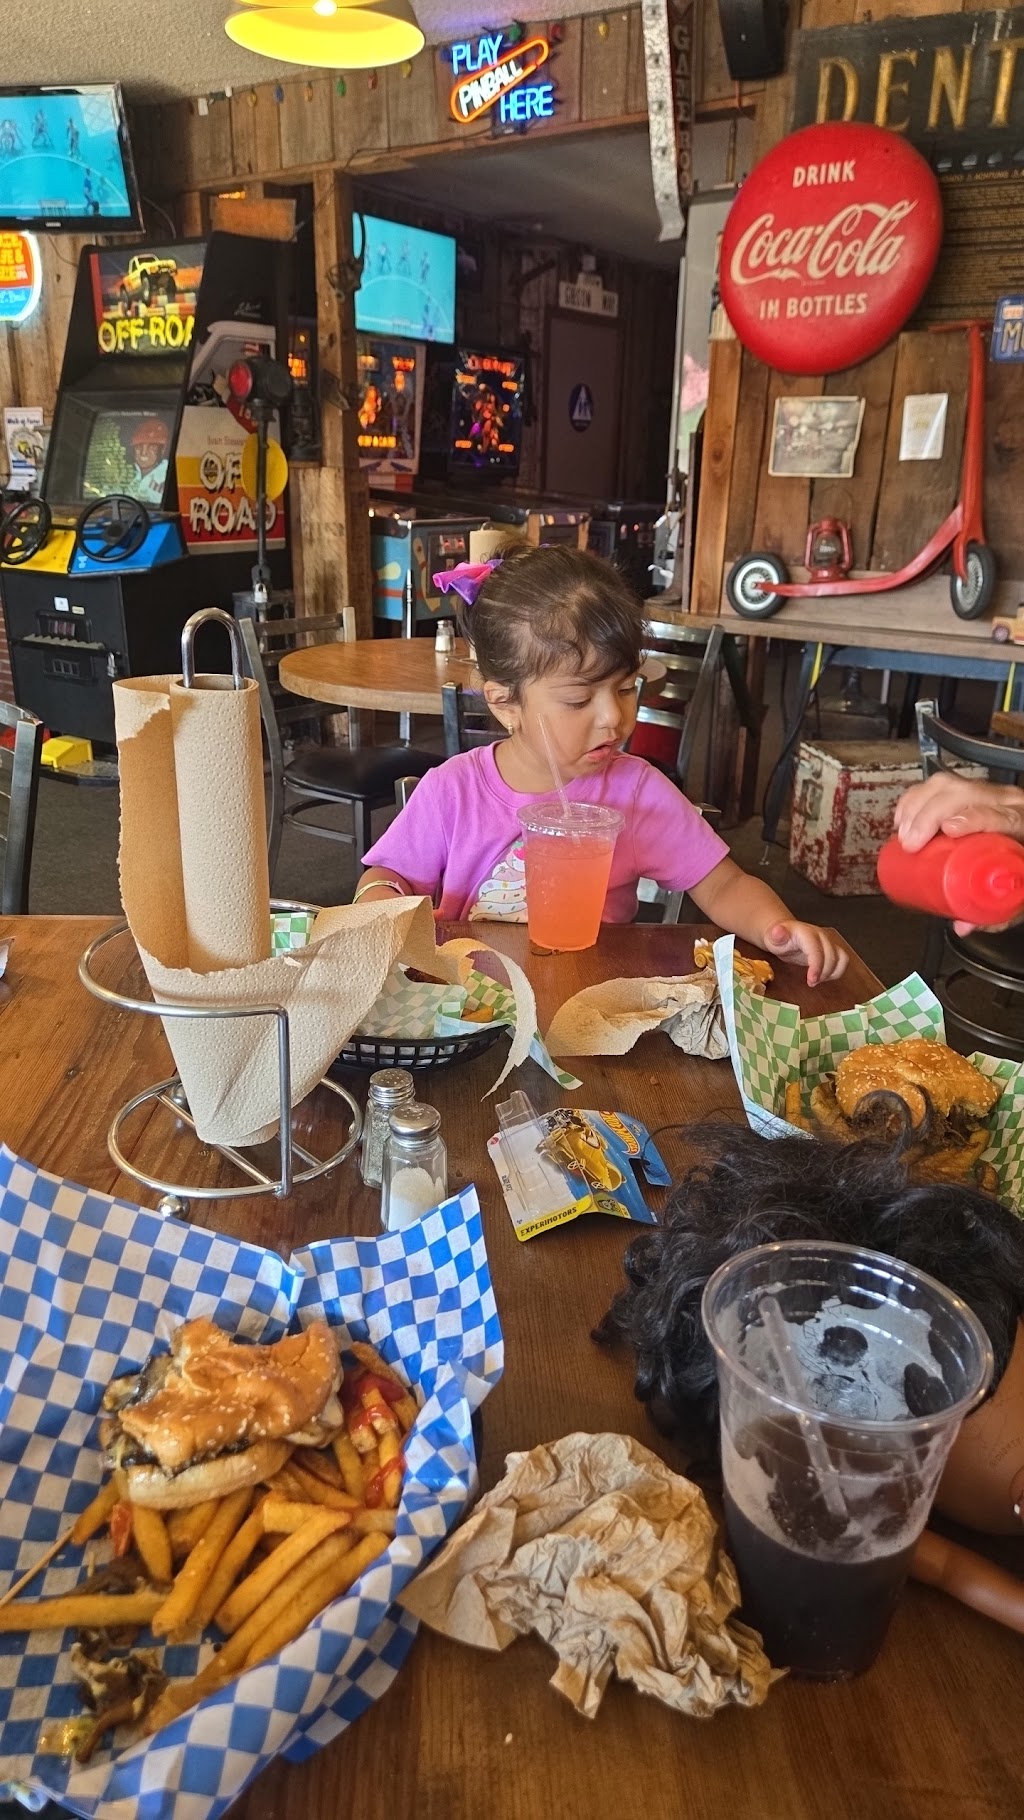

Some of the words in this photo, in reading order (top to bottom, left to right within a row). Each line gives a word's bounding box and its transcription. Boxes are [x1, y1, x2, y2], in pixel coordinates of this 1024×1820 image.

[452, 34, 503, 75] PLAY
[458, 59, 524, 117] PINBALL
[500, 85, 553, 123] HERE
[792, 160, 857, 189] DRINK
[730, 199, 919, 287] Coca-Cola
[759, 300, 779, 321] IN
[786, 293, 869, 319] BOTTLES
[200, 451, 243, 491] OF
[520, 1207, 578, 1237] EXPERIMOTORS
